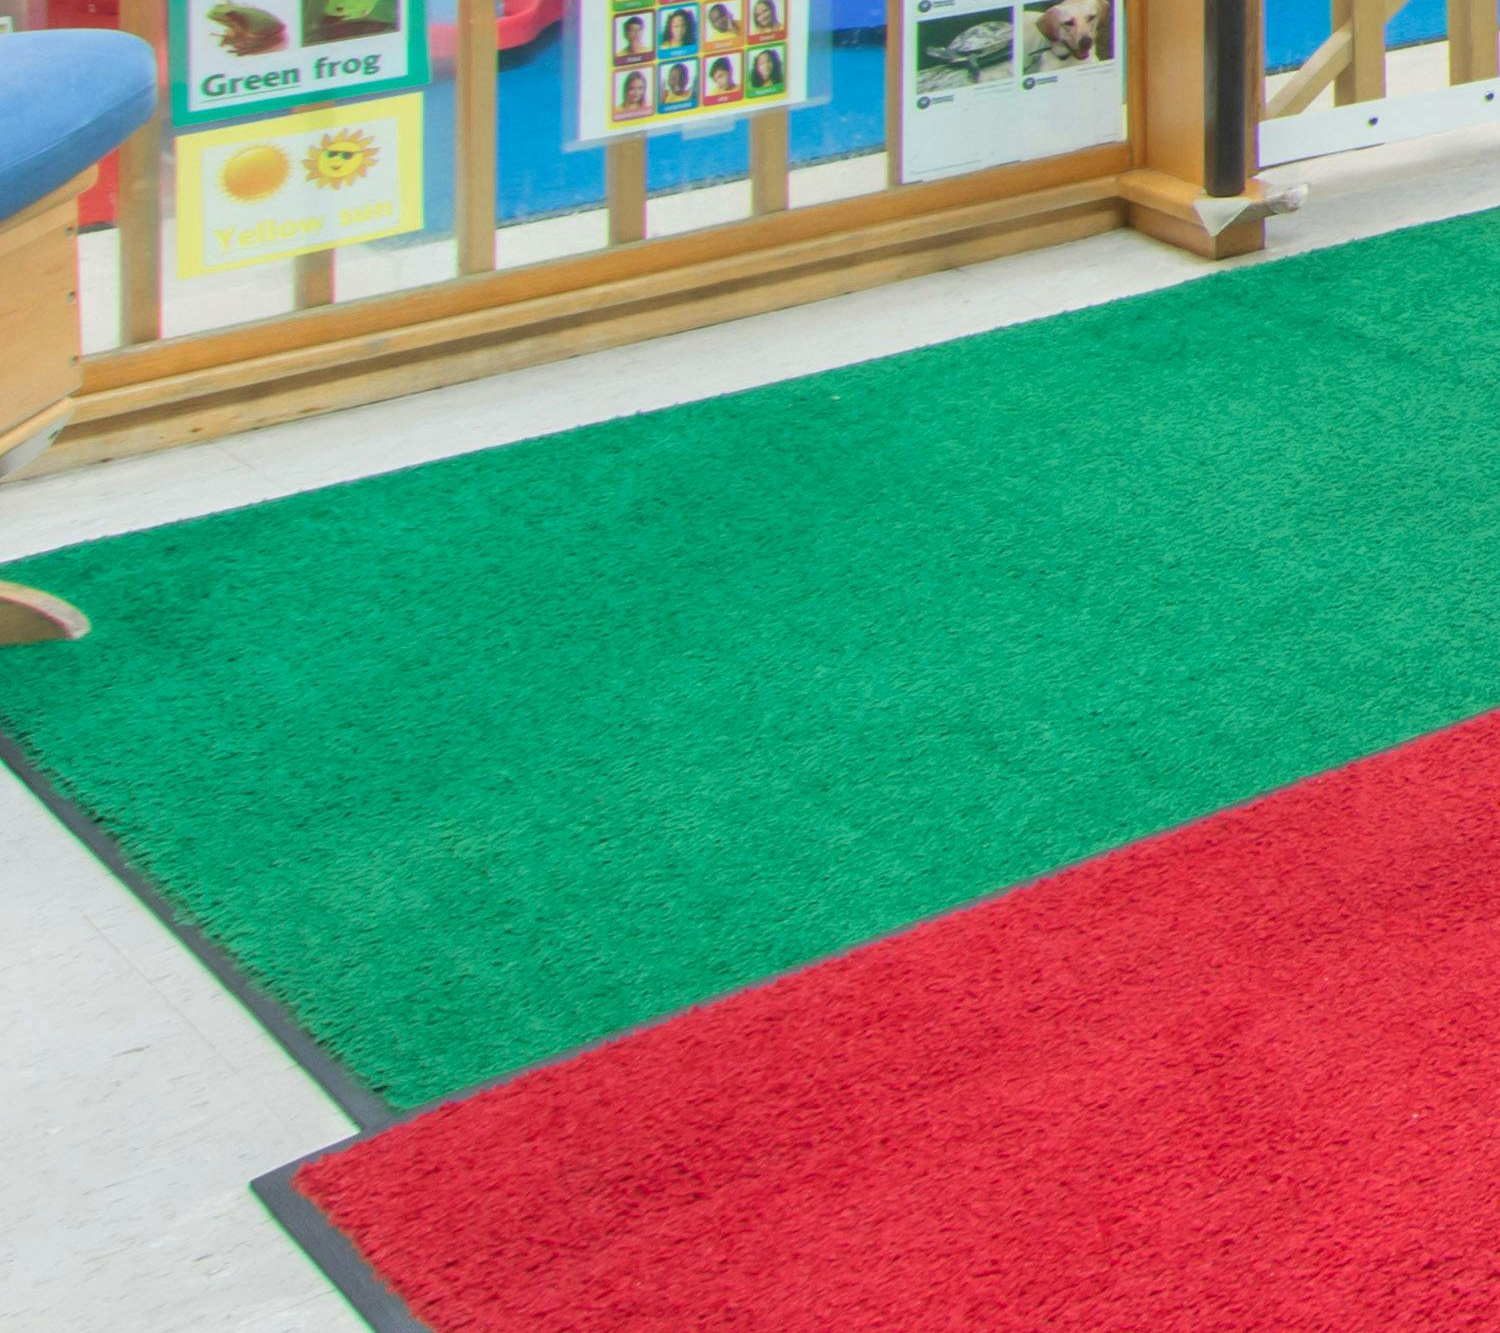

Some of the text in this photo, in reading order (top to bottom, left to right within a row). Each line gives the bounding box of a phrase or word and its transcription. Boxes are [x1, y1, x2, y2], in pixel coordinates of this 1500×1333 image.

[200, 53, 382, 97] Green frog
[213, 199, 394, 252] Yellow sun
